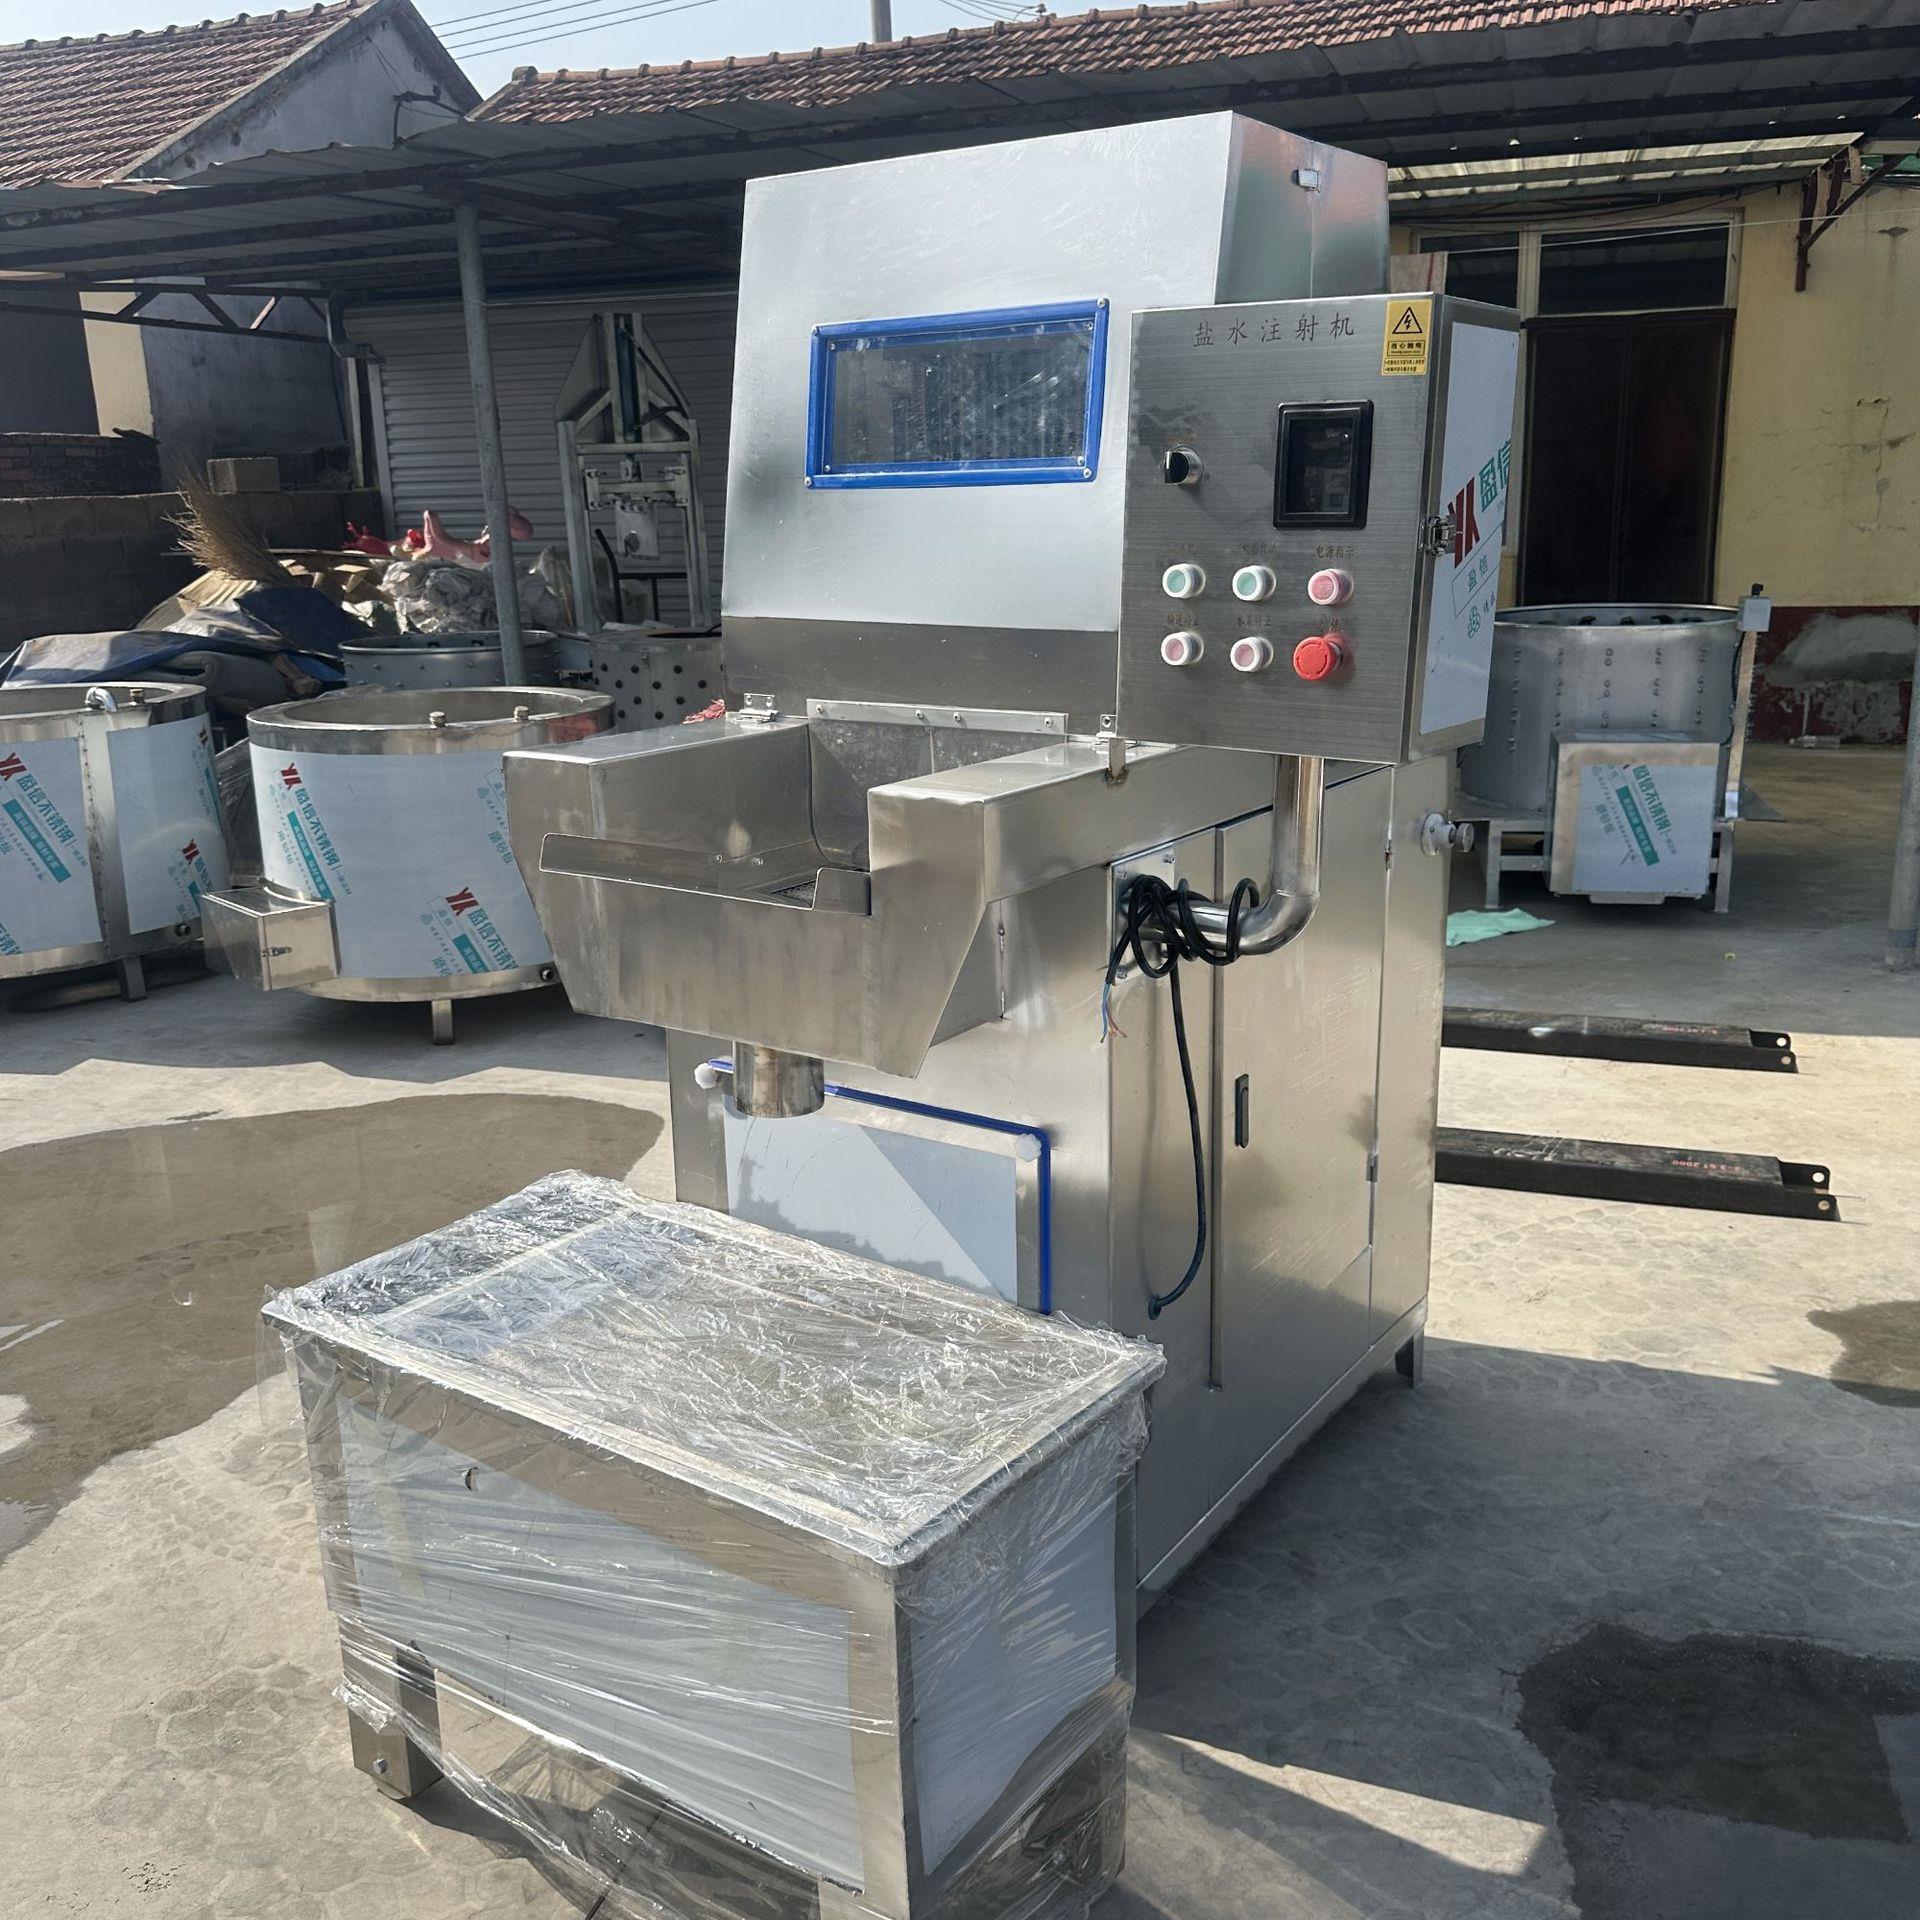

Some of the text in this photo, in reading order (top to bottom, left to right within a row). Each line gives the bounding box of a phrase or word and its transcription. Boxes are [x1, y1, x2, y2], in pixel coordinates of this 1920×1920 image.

[1193, 313, 1354, 347] 盐水注射机
[1315, 545, 1354, 560] 电源指示
[17, 773, 75, 845] 盈信不锈钢
[295, 787, 340, 866] 盈信不锈钢
[1633, 765, 1671, 831] 盈信不锈钢
